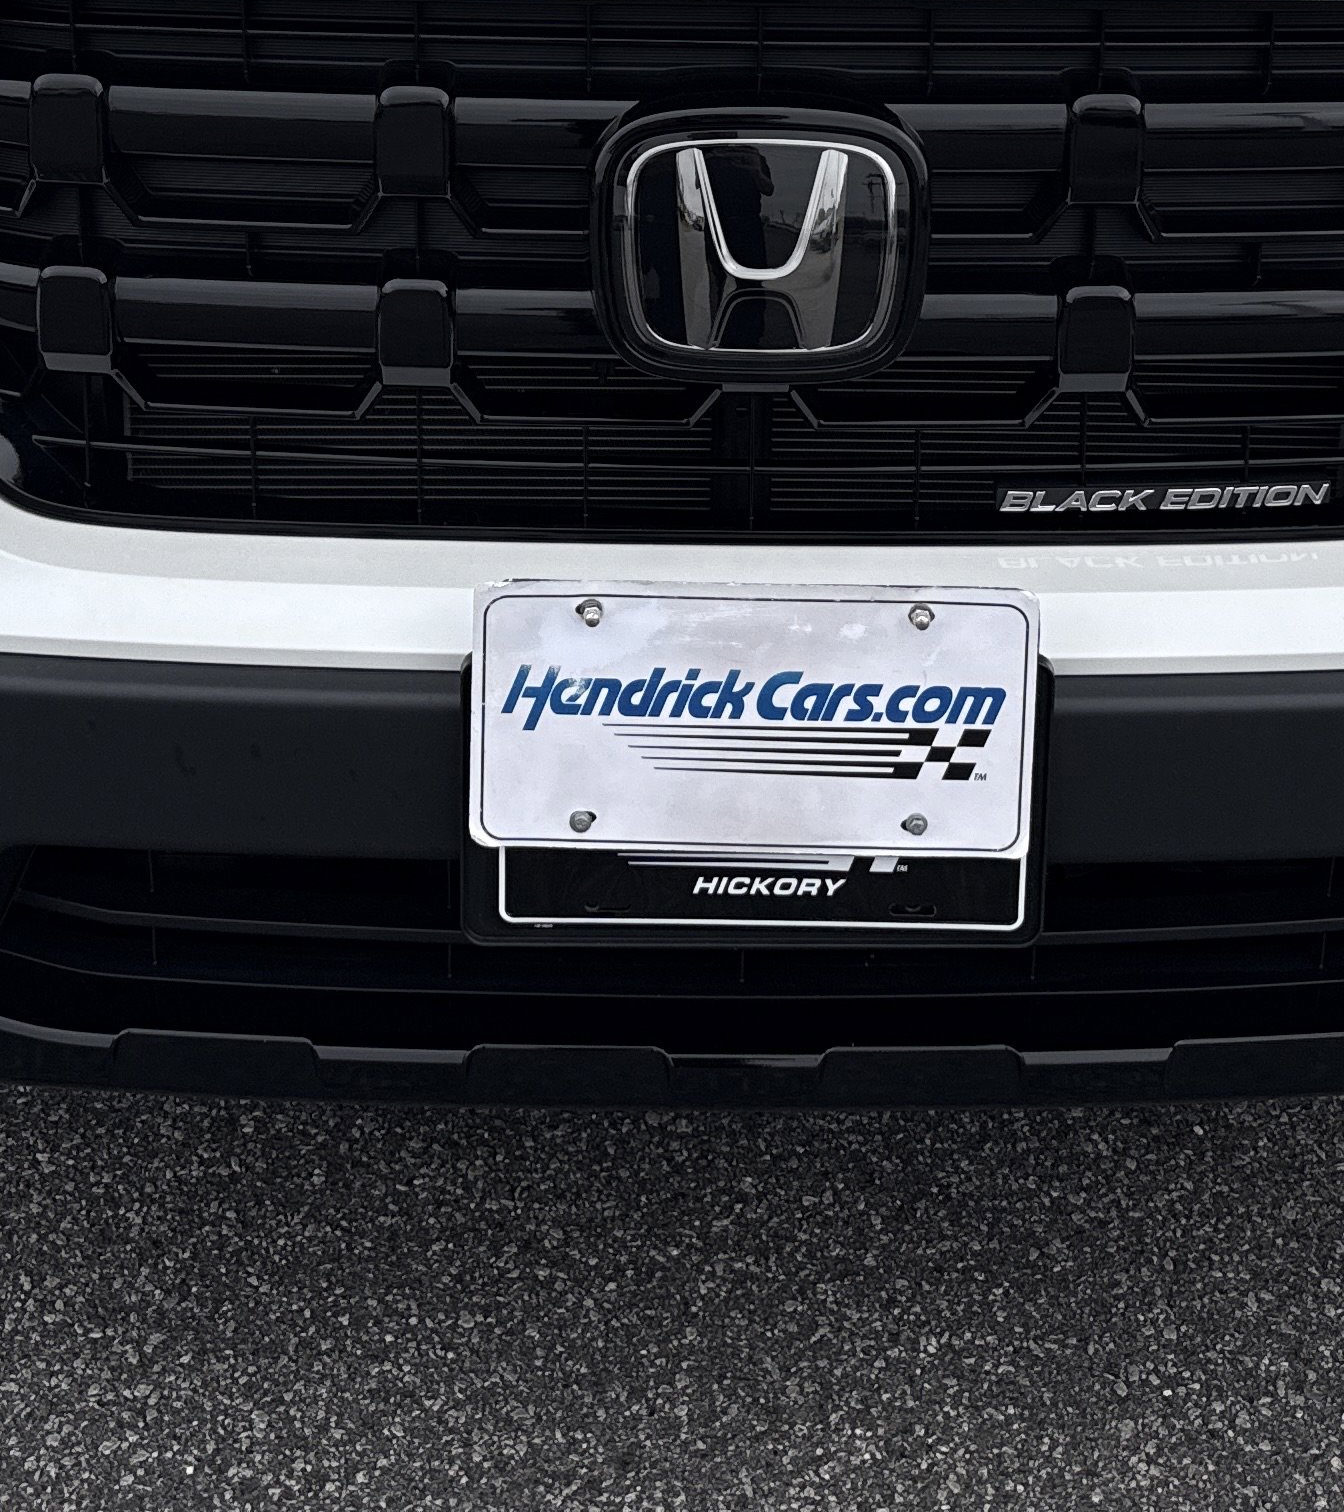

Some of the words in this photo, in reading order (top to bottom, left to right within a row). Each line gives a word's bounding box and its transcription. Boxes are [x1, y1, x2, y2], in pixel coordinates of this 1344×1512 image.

[999, 489, 1155, 512] BLACK
[1159, 483, 1330, 510] EDITION
[974, 773, 987, 781] TM
[692, 876, 847, 897] HICKORY
